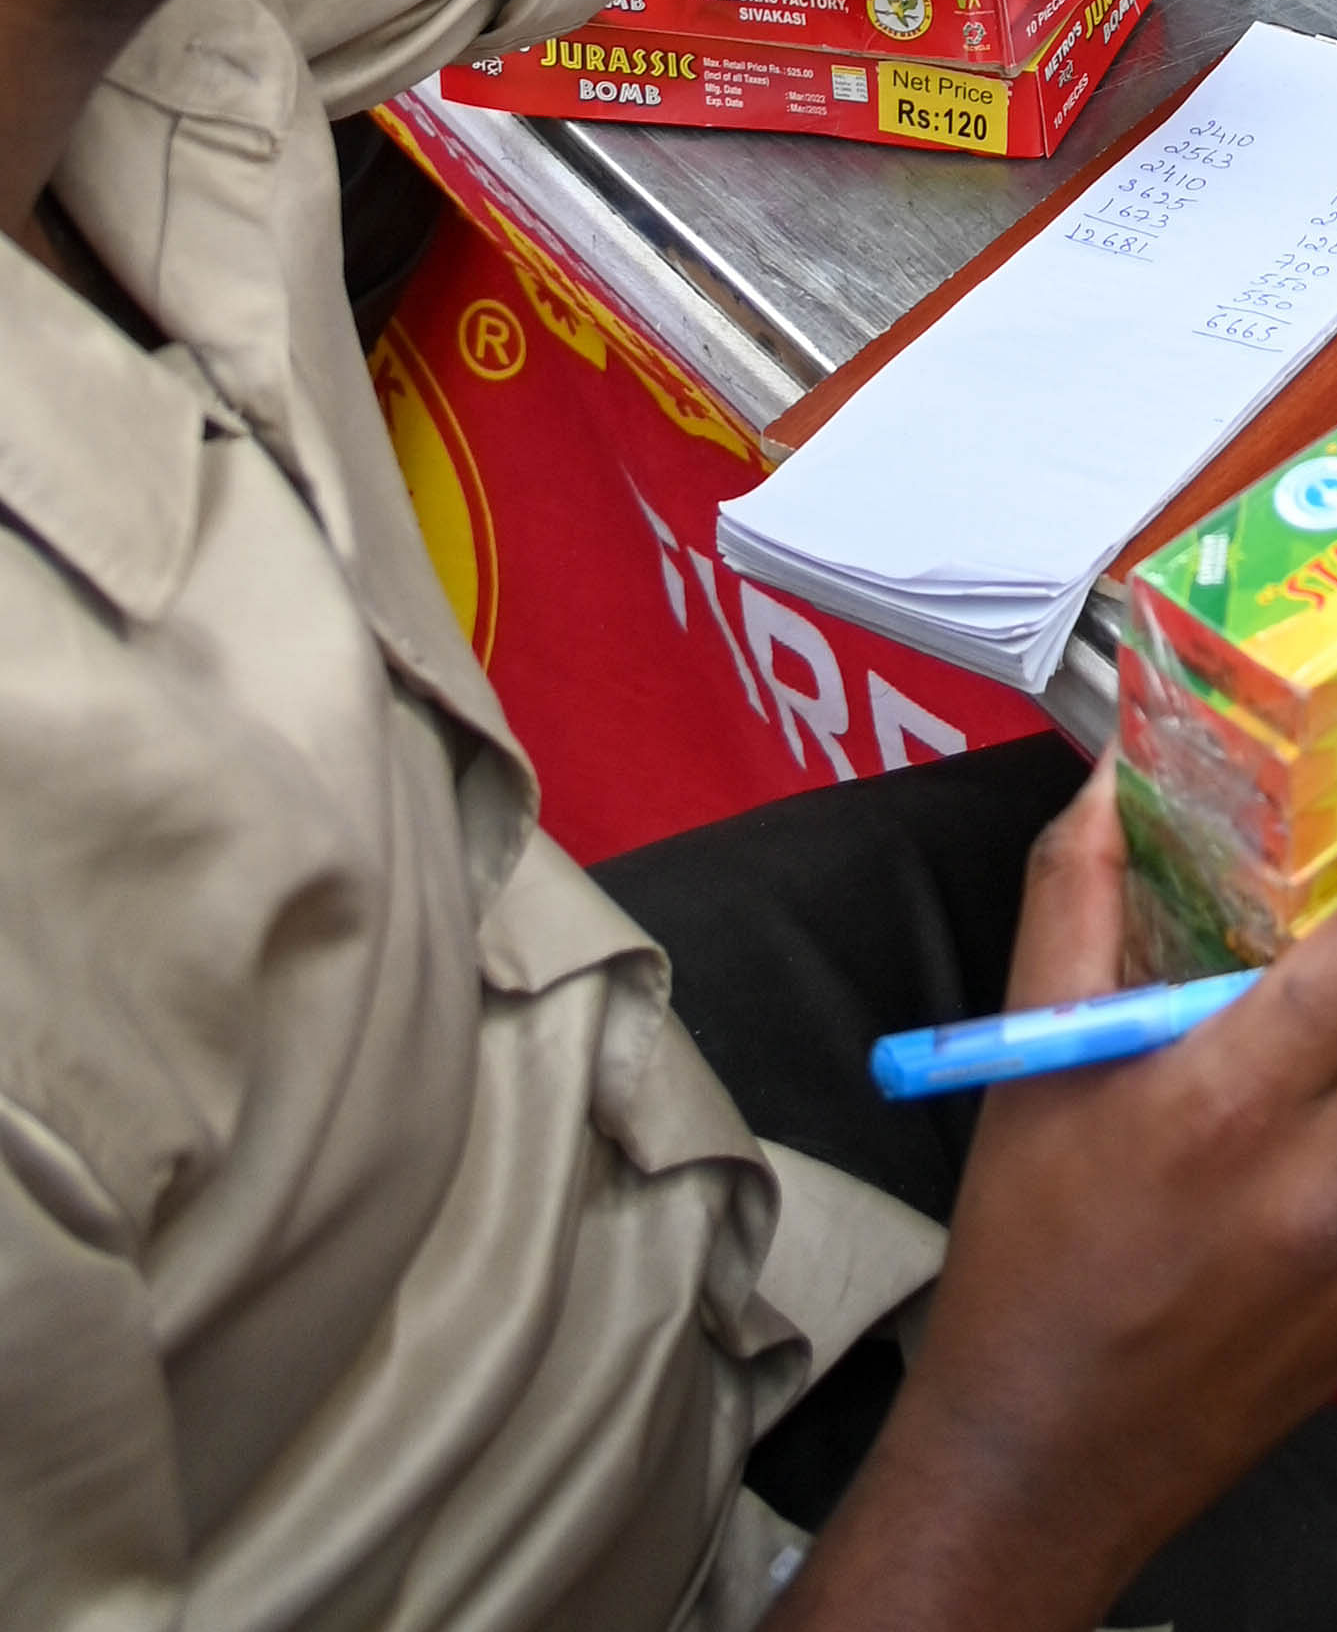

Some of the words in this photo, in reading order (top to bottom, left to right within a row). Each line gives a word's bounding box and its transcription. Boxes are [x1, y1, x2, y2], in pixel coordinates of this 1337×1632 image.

[739, 7, 807, 26] SIVAKASI
[1026, 20, 1037, 38] 10
[540, 38, 698, 80] JURASSIC
[723, 58, 745, 71] Retail
[747, 61, 768, 74] Price
[1044, 21, 1083, 83] METRO'S
[579, 78, 663, 105] BOMB
[723, 84, 743, 96] Date
[724, 97, 744, 108] Date
[893, 68, 931, 93] Net
[938, 76, 994, 106] Price
[1053, 110, 1064, 131] 10
[1062, 72, 1090, 118] PIECES
[898, 98, 988, 141] Rs:120
[1189, 118, 1256, 149] 2410
[1162, 139, 1235, 170] 2563
[1139, 158, 1208, 192] 2410
[1117, 177, 1200, 210] 3625
[1098, 198, 1171, 230] 1673
[1065, 222, 1152, 255] 12681
[1275, 253, 1331, 278] 700
[1249, 270, 1308, 293] 550
[1233, 288, 1294, 312] 550
[1205, 312, 1274, 343] 6665
